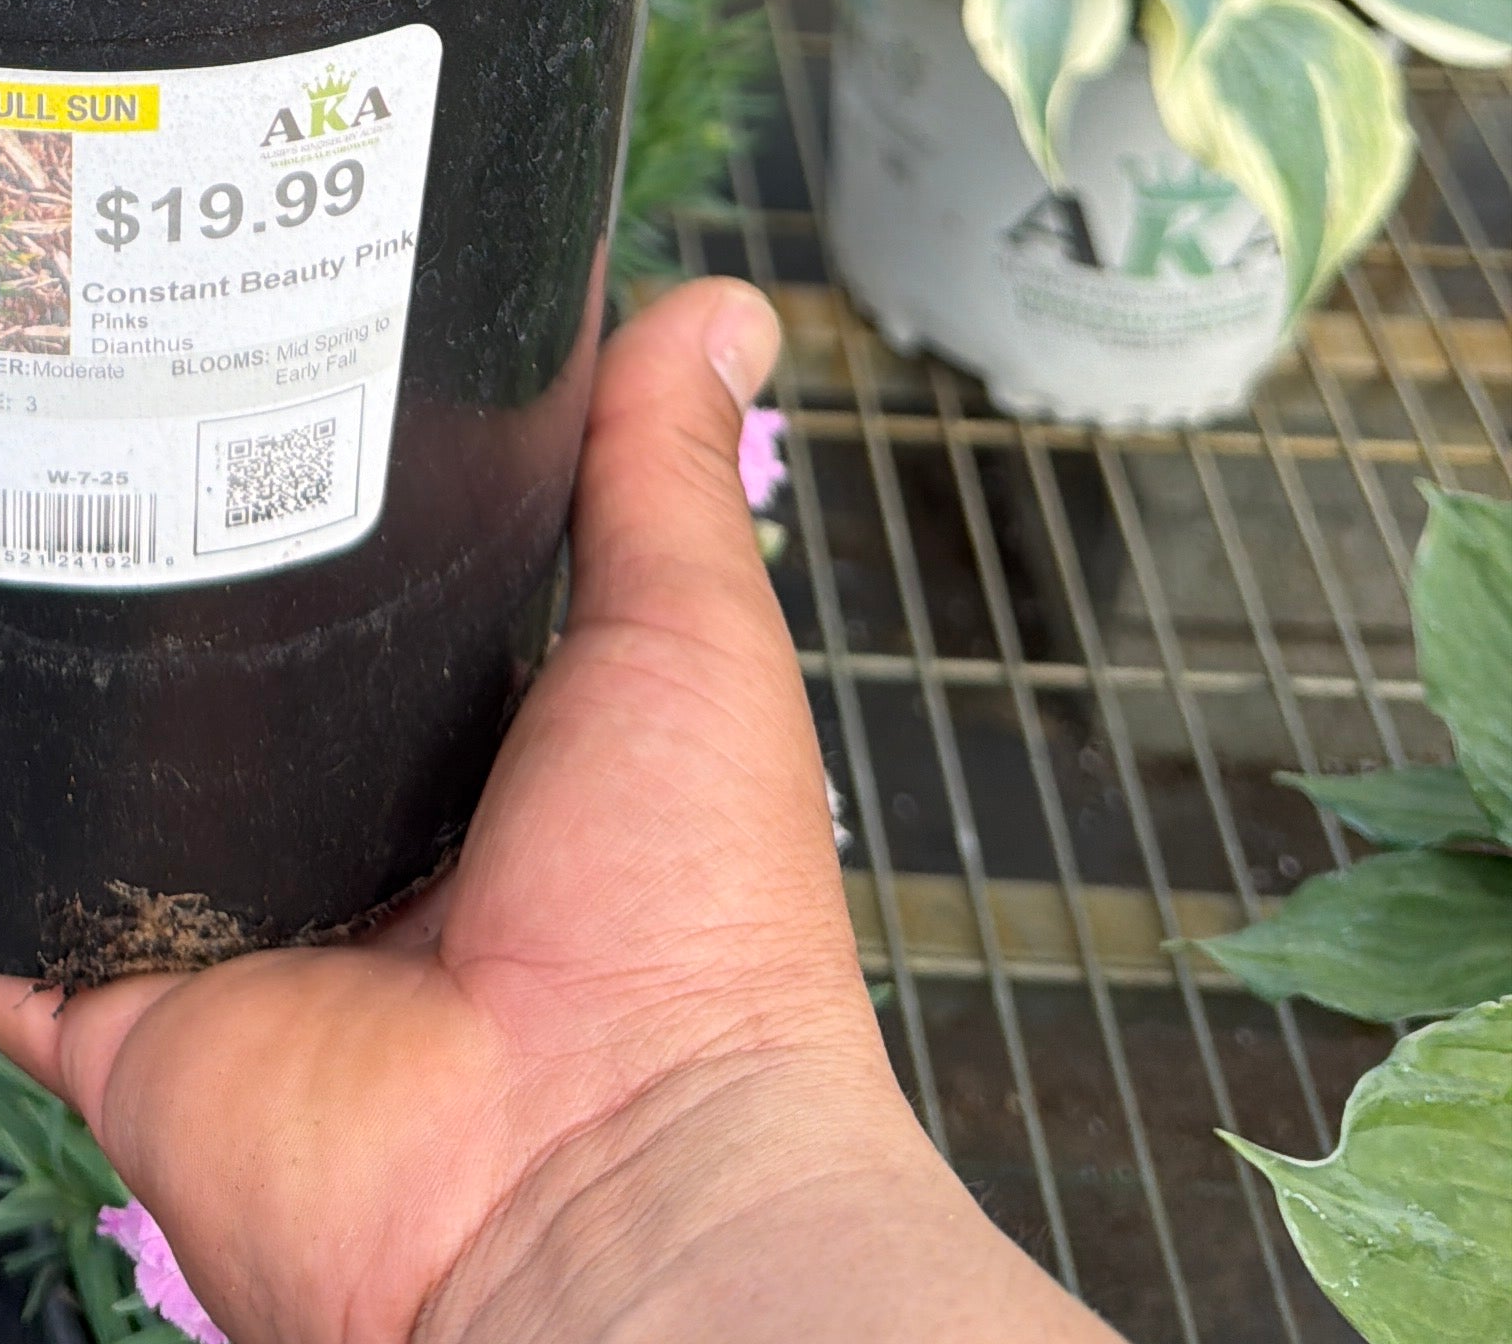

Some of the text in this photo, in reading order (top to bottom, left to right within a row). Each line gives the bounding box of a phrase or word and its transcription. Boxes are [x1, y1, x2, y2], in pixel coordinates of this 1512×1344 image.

[67, 94, 136, 122] SUN
[259, 85, 392, 147] AKA
[94, 158, 365, 252] $19.99
[82, 229, 415, 303] Constant Beauty Pink
[91, 312, 148, 330] Pinks
[91, 334, 194, 355] Dianthus
[171, 316, 390, 376] BLOOMS: Mid Spring to
[276, 348, 357, 385] Early Fall
[26, 396, 37, 412] 3
[47, 469, 129, 485] W-7-25
[58, 554, 132, 568] 24192
